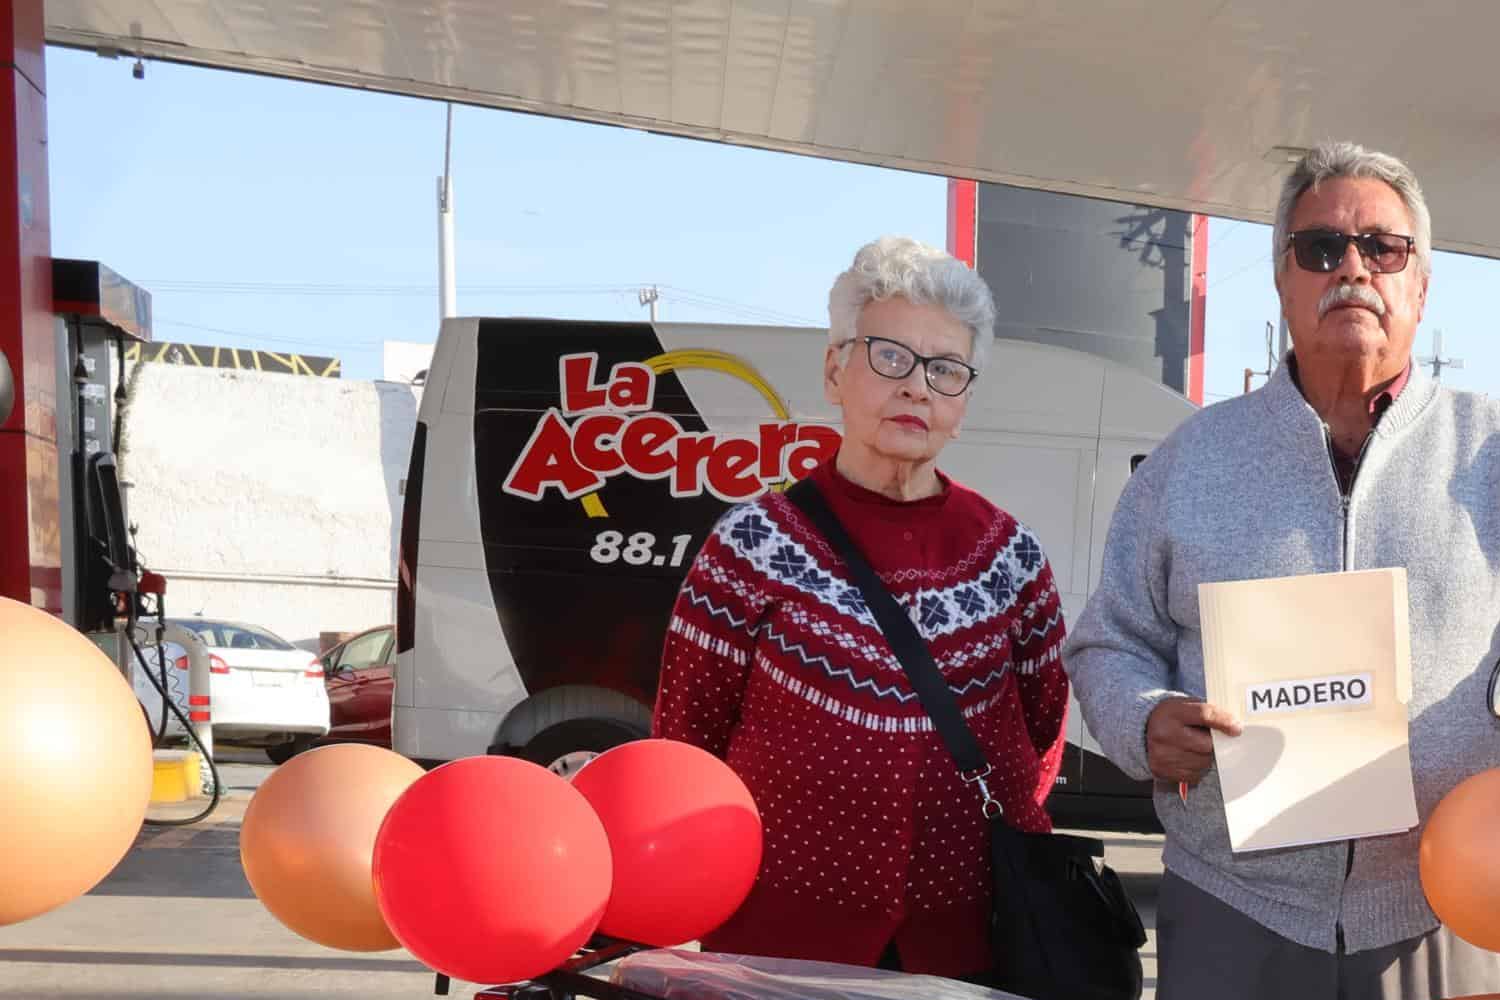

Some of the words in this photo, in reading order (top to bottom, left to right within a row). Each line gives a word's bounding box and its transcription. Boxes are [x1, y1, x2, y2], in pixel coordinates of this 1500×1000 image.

[560, 352, 656, 417] La
[503, 407, 843, 502] Acerera
[590, 530, 693, 567] 88.1
[1251, 679, 1367, 711] MADERO
